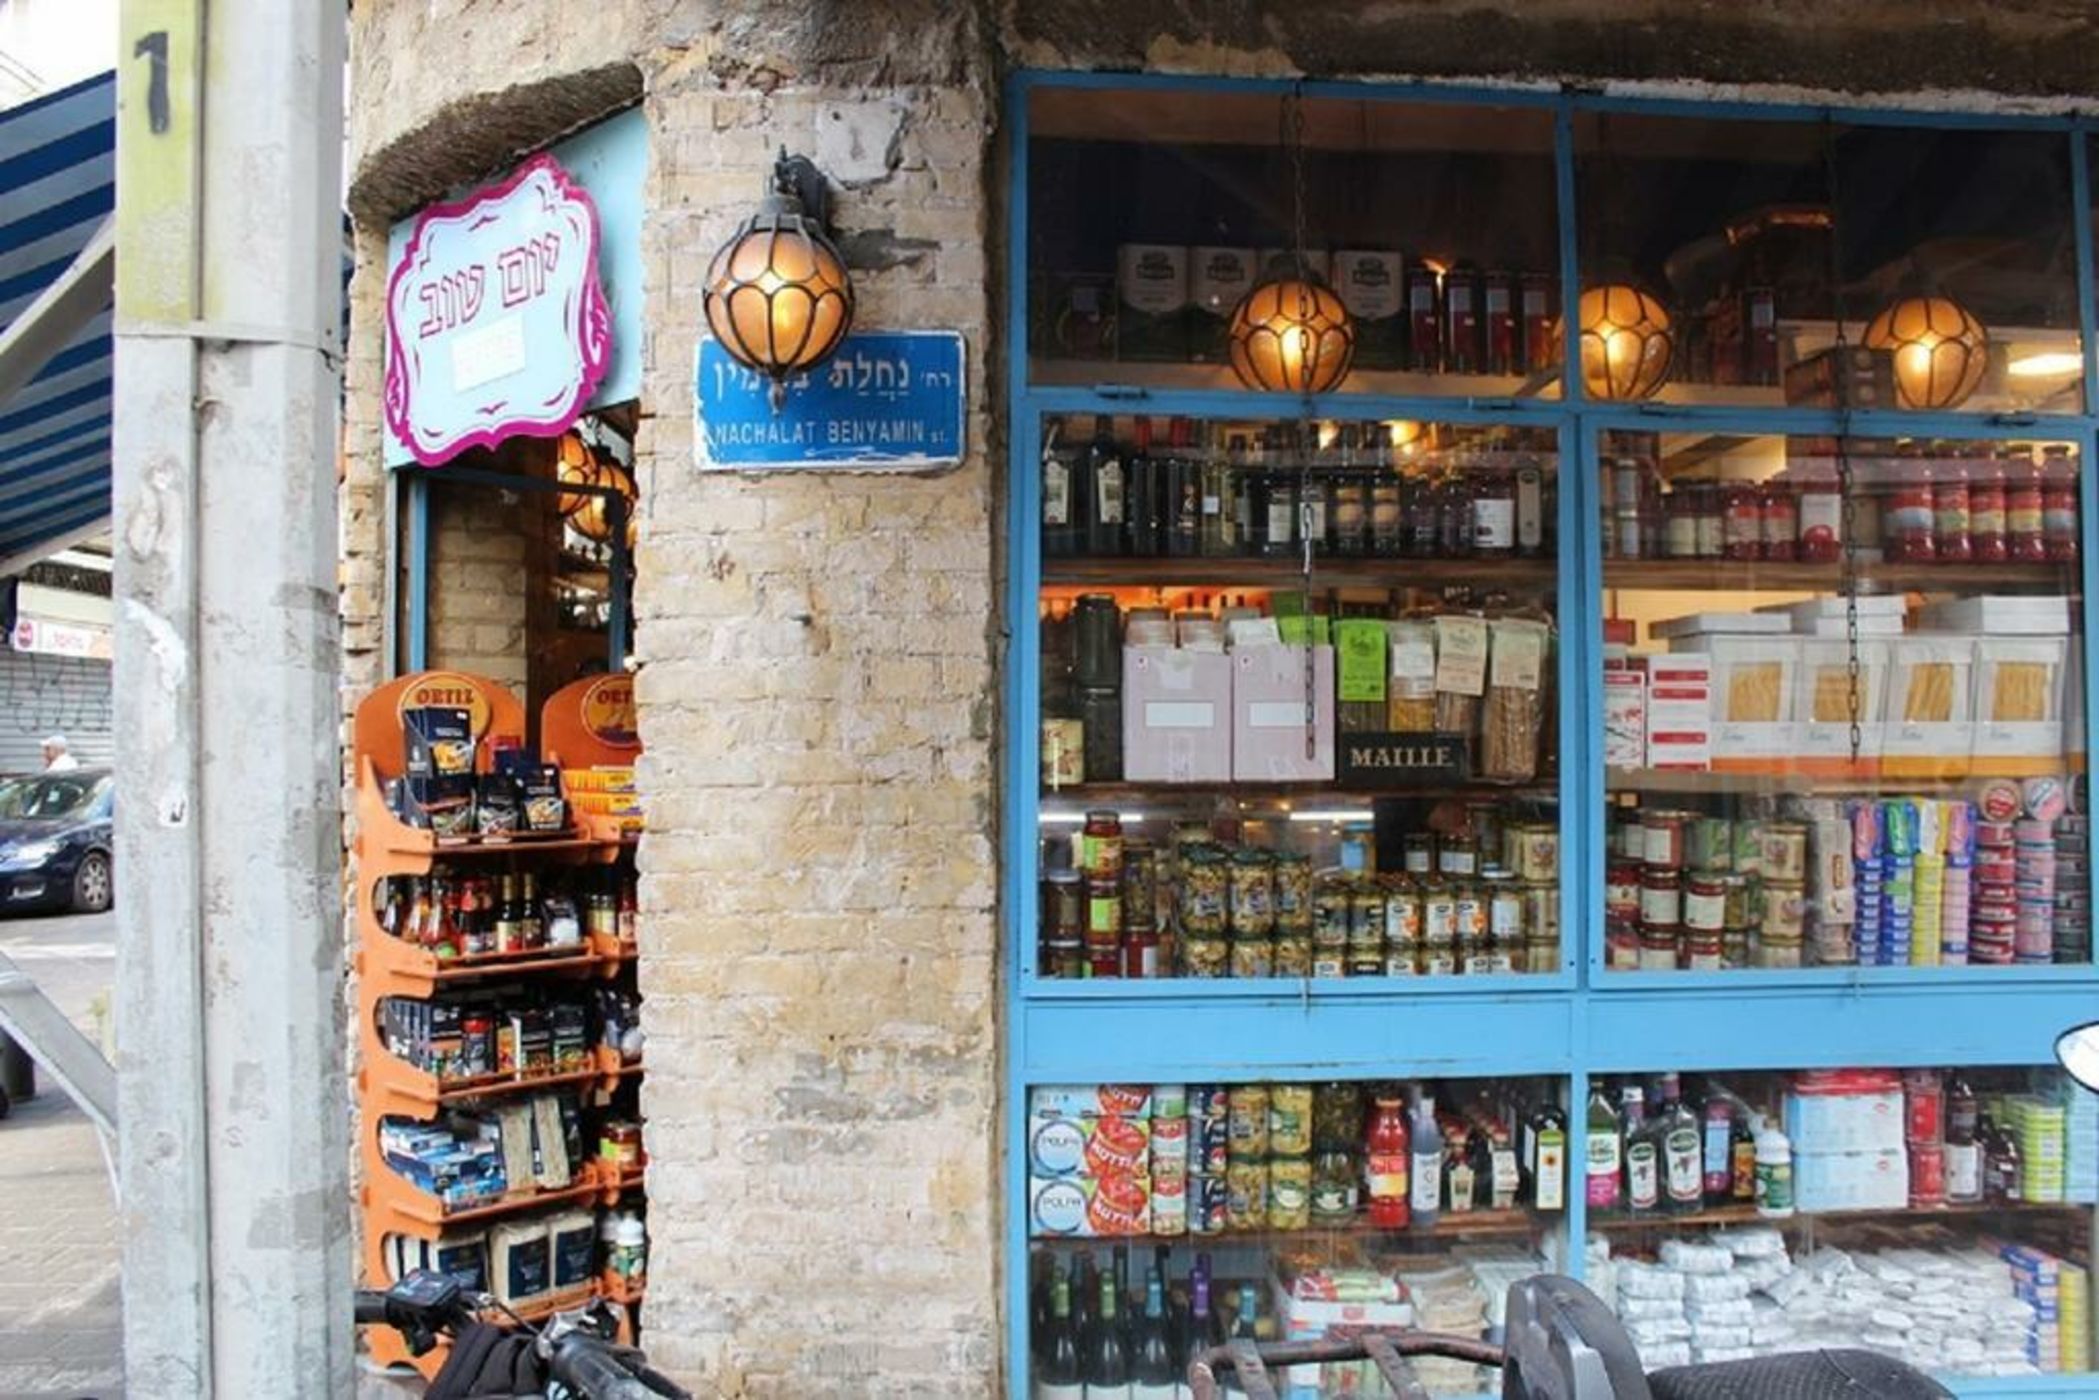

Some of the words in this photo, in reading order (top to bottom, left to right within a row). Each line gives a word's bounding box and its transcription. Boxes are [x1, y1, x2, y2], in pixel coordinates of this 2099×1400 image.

[134, 31, 170, 135] 1
[419, 265, 485, 339] טוב
[498, 232, 561, 308] יום
[715, 421, 815, 445] NACHALAT
[827, 419, 924, 445] BENYAMIN
[1350, 747, 1455, 768] MAILLE
